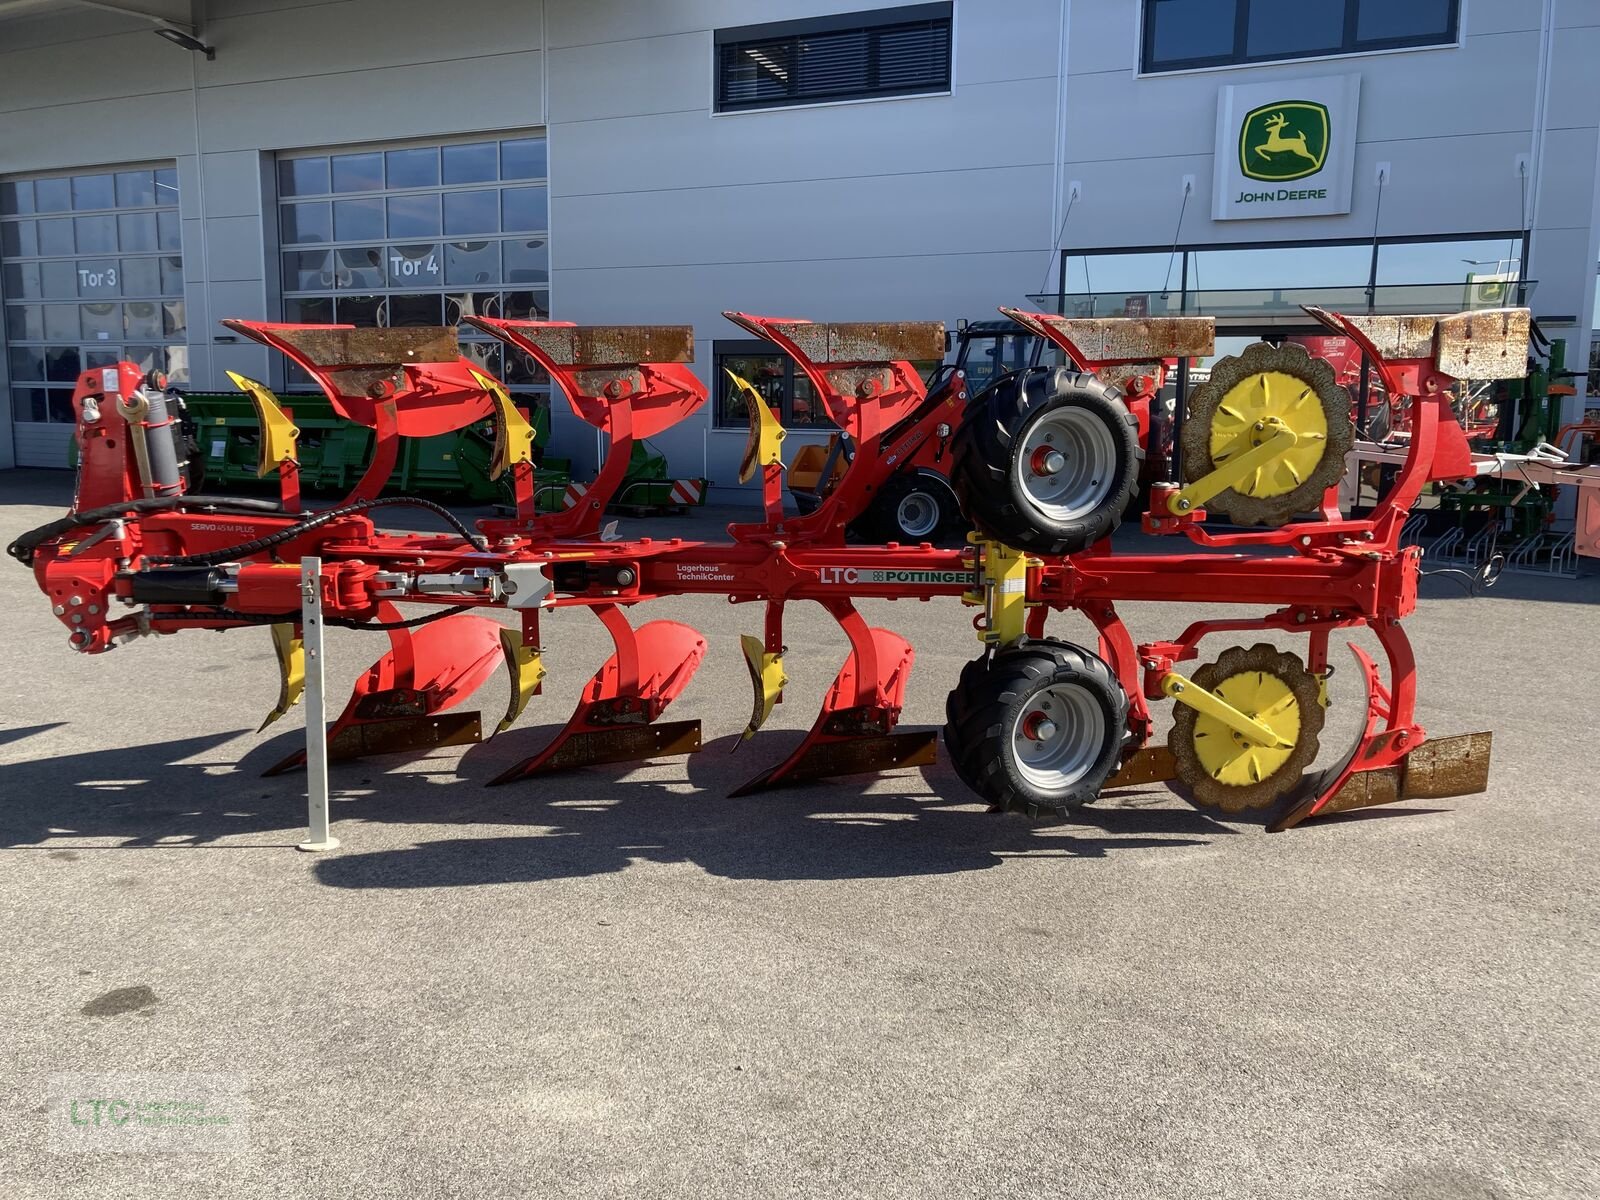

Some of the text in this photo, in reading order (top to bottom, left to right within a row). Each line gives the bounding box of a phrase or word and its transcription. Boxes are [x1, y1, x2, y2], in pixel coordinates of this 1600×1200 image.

[1235, 189, 1327, 203] JOHN DEERE
[390, 255, 439, 276] Tor 4
[78, 268, 116, 287] Tor 3
[191, 523, 216, 531] SERVO
[235, 525, 255, 533] PLUS
[676, 564, 719, 573] Lagerhaus
[820, 567, 859, 584] LTC
[676, 572, 735, 581] TechnikCenter
